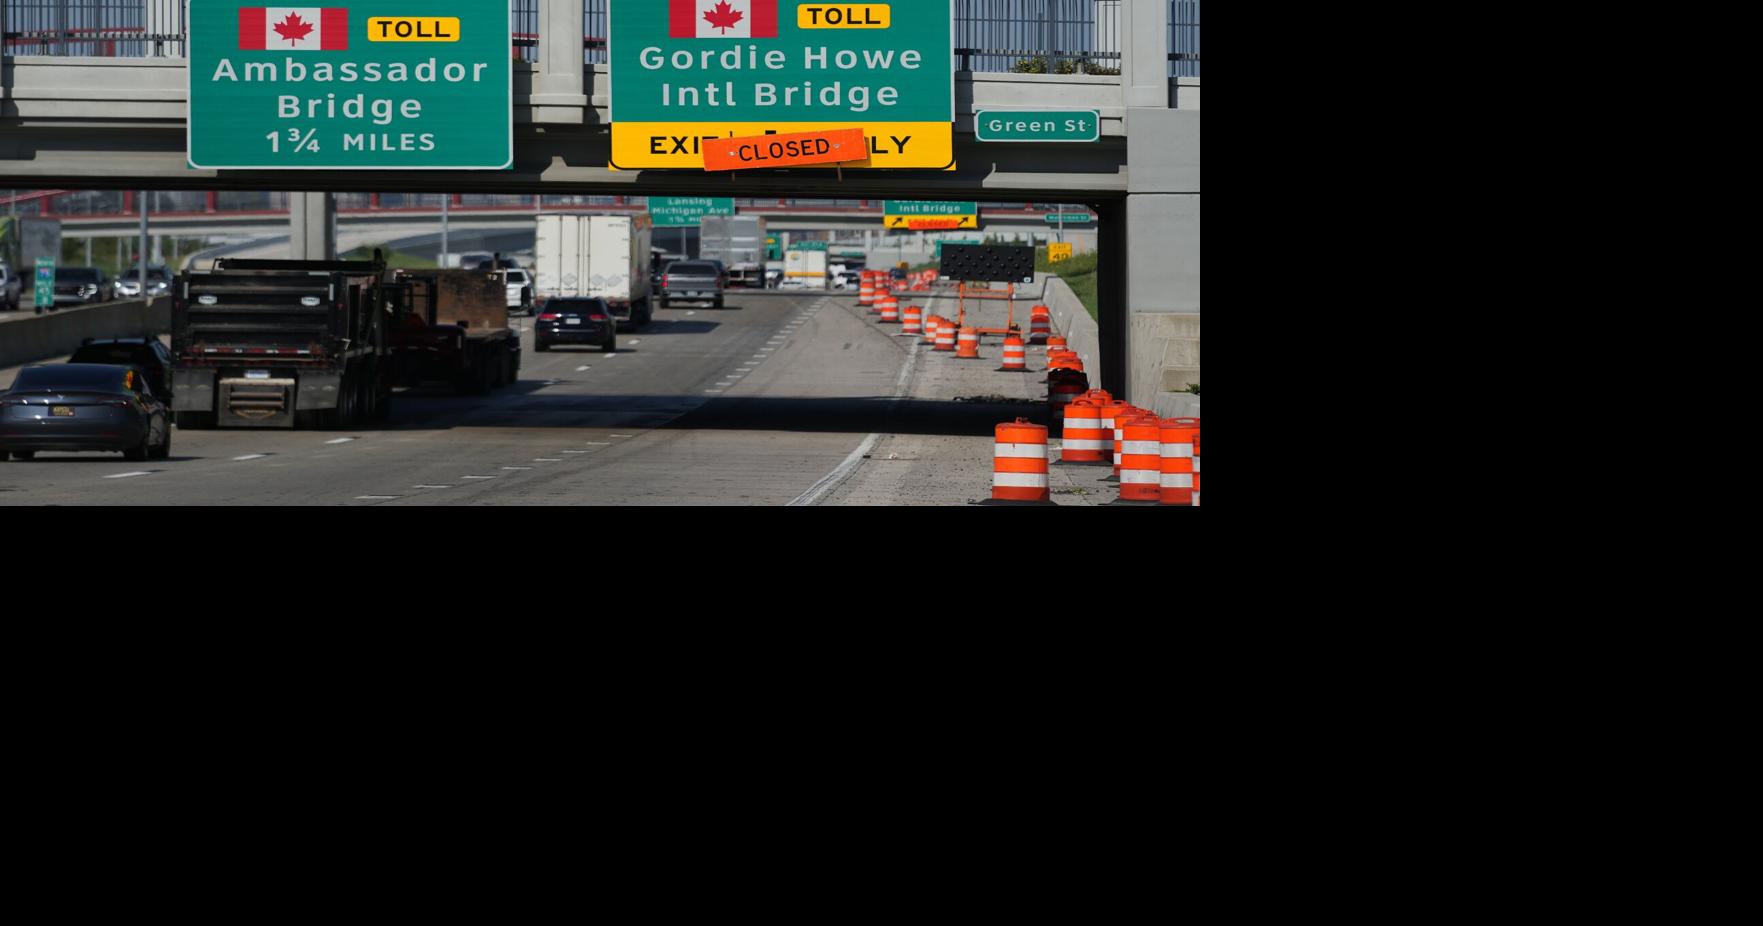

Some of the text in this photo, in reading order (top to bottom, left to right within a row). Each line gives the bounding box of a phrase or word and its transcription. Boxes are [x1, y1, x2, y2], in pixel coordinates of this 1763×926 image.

[807, 7, 881, 25] TOLL
[377, 20, 451, 38] TOLL
[639, 45, 922, 70] Gordie Howe
[212, 57, 488, 82] Ambassador
[662, 82, 899, 112] Intl Bridge
[278, 93, 422, 125] Bridge
[988, 119, 1086, 132] Green St
[343, 133, 435, 151] MILES
[650, 136, 719, 154] EXI
[738, 138, 831, 162] CLOSED
[668, 197, 713, 207] Lansing
[899, 204, 961, 214] Intl Bridge
[652, 207, 704, 216] Michigan
